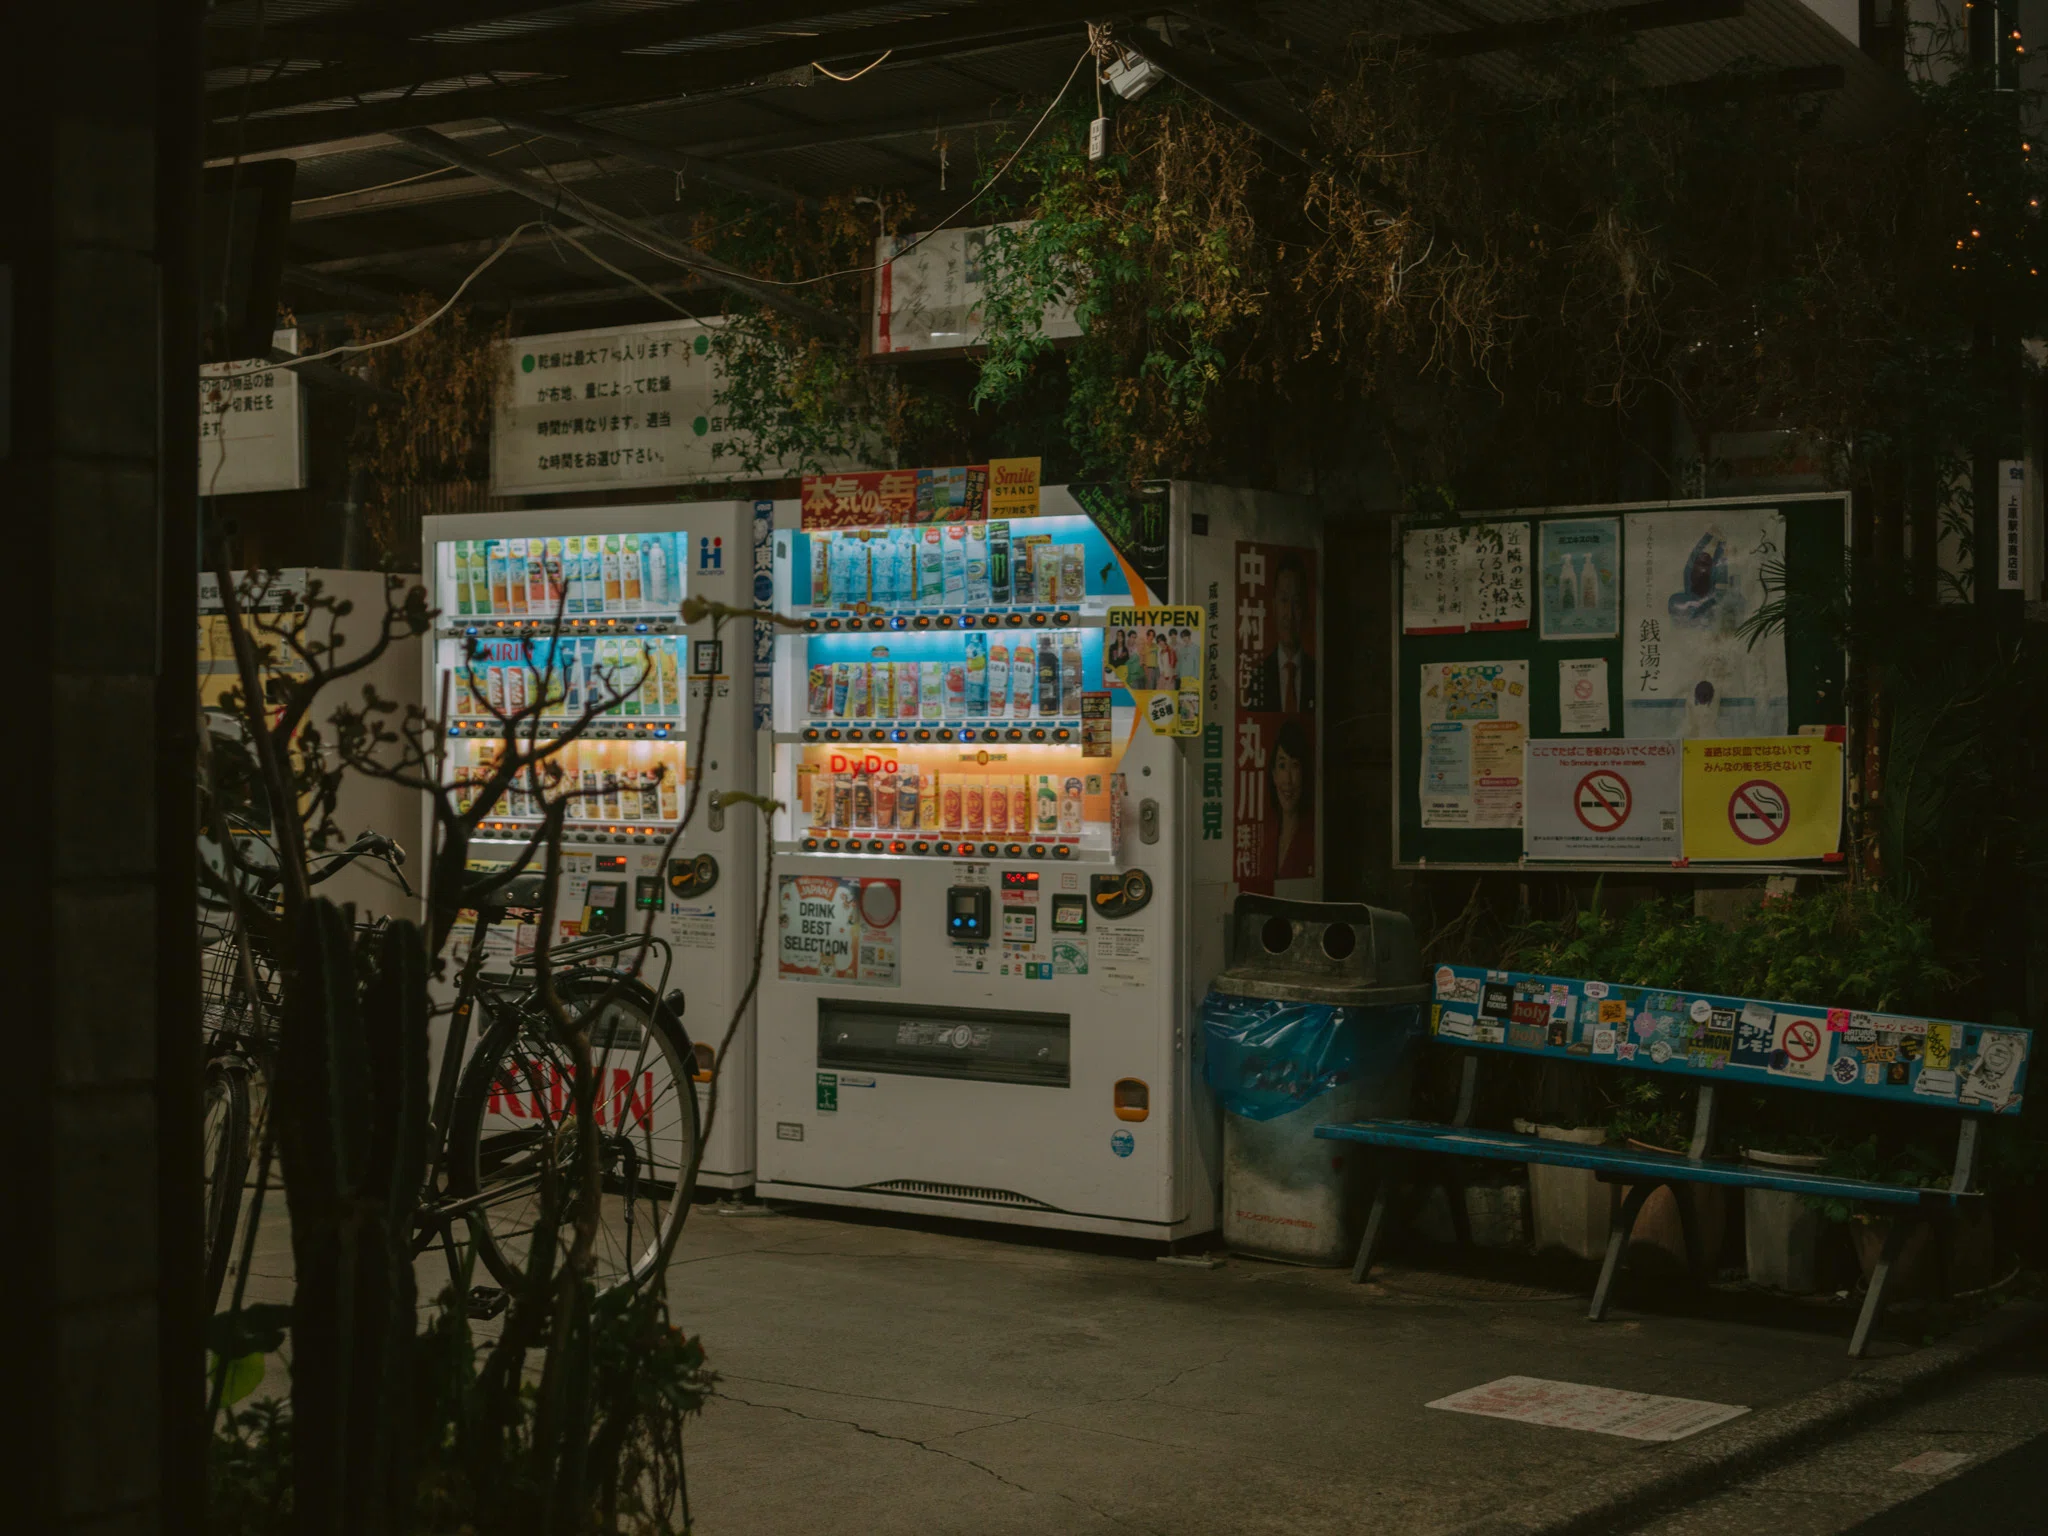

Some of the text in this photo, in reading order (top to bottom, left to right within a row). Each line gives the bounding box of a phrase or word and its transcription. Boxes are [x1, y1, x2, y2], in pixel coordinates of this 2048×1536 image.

[994, 465, 1036, 485] Smile
[995, 485, 1035, 496] STAND
[1109, 610, 1199, 627] ENHYPEN
[483, 642, 533, 662] KIRIN
[1639, 618, 1661, 692] 銭湯だ
[1532, 746, 1675, 757] ここでたばこを吸わないでください
[1703, 744, 1812, 758] 道路は灰皿ではないです
[830, 754, 899, 779] DyDo
[1570, 760, 1599, 768] Smoking
[1703, 759, 1812, 773] みんなの街を汚さないで
[1203, 721, 1223, 840] 自民党
[799, 901, 836, 920] DRINK
[801, 919, 832, 936] BEST
[1513, 1003, 1548, 1024] holy
[1511, 1027, 1543, 1047] holy
